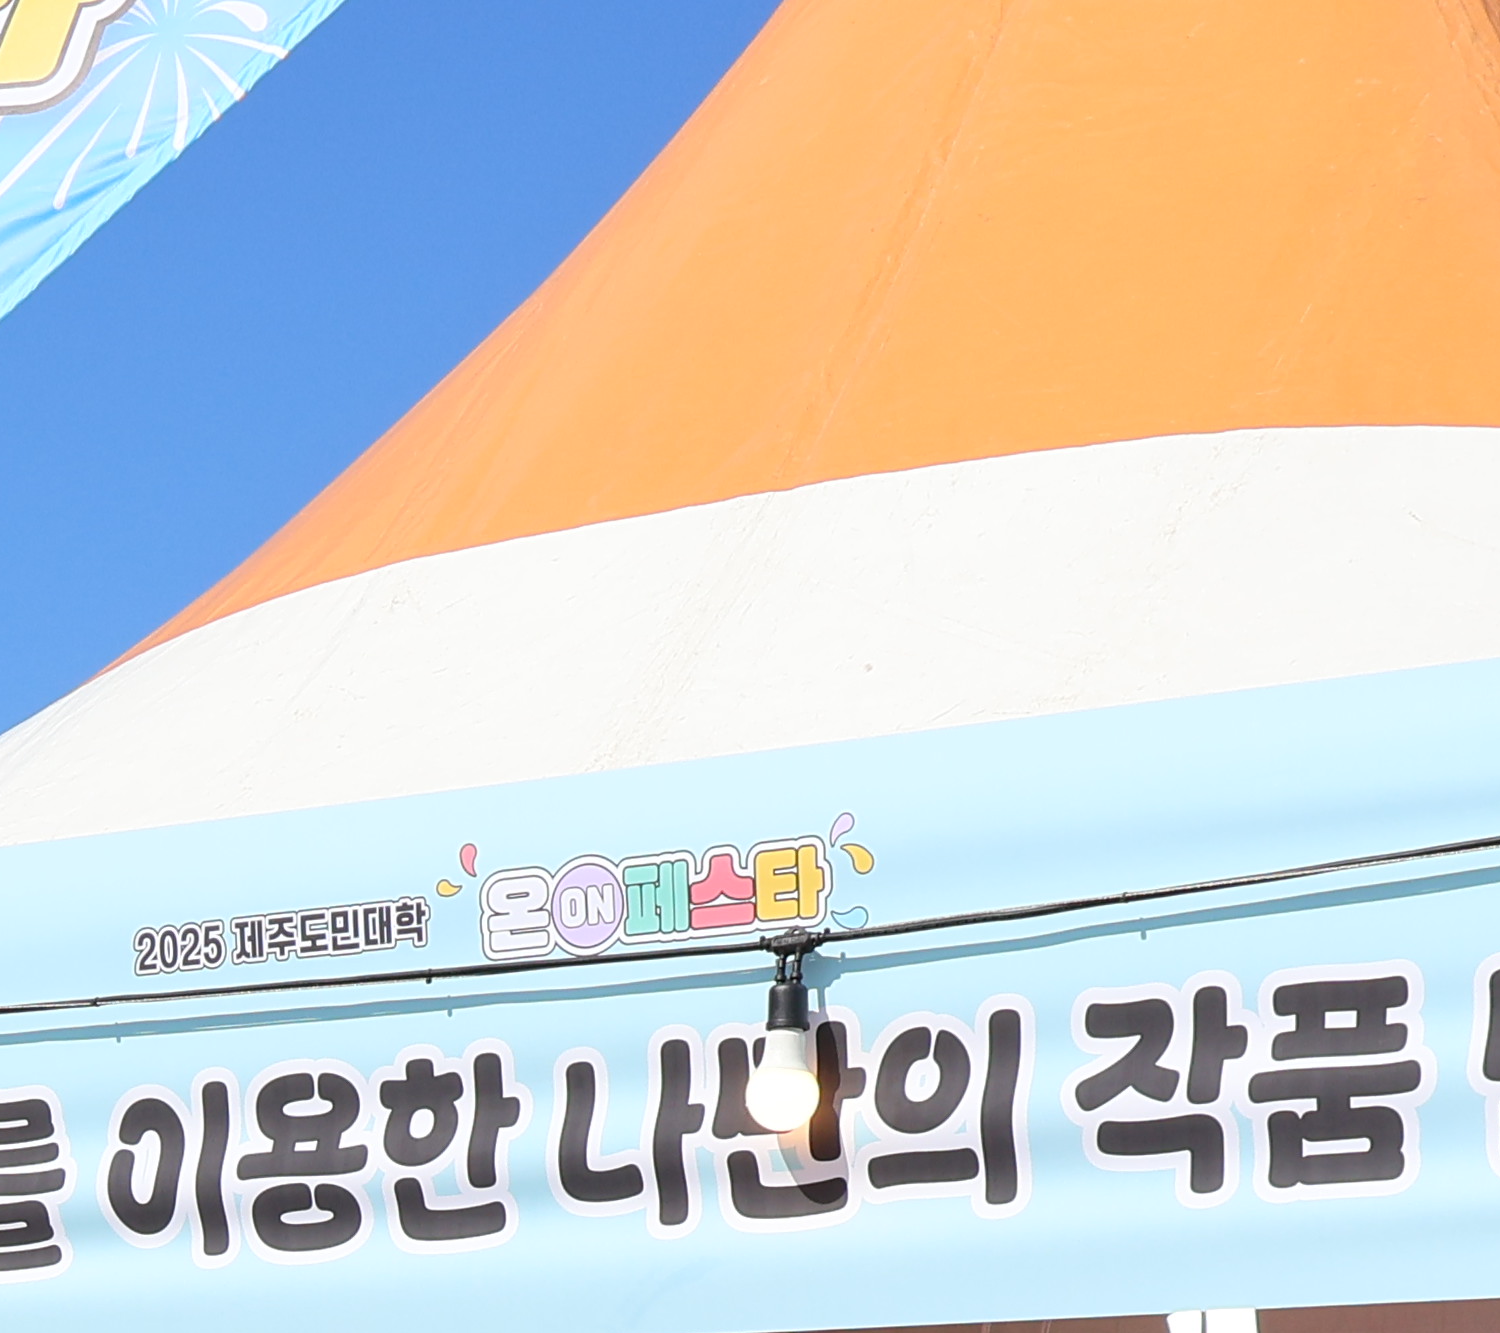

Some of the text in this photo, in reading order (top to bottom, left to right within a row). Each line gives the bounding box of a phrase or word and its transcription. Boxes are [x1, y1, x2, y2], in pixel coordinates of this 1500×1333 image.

[137, 930, 224, 973] 2025
[234, 902, 429, 963] 제주도민대학
[109, 1053, 521, 1257] 이용한
[563, 1005, 1022, 1224] 나만의
[1077, 973, 1421, 1193] 작품
